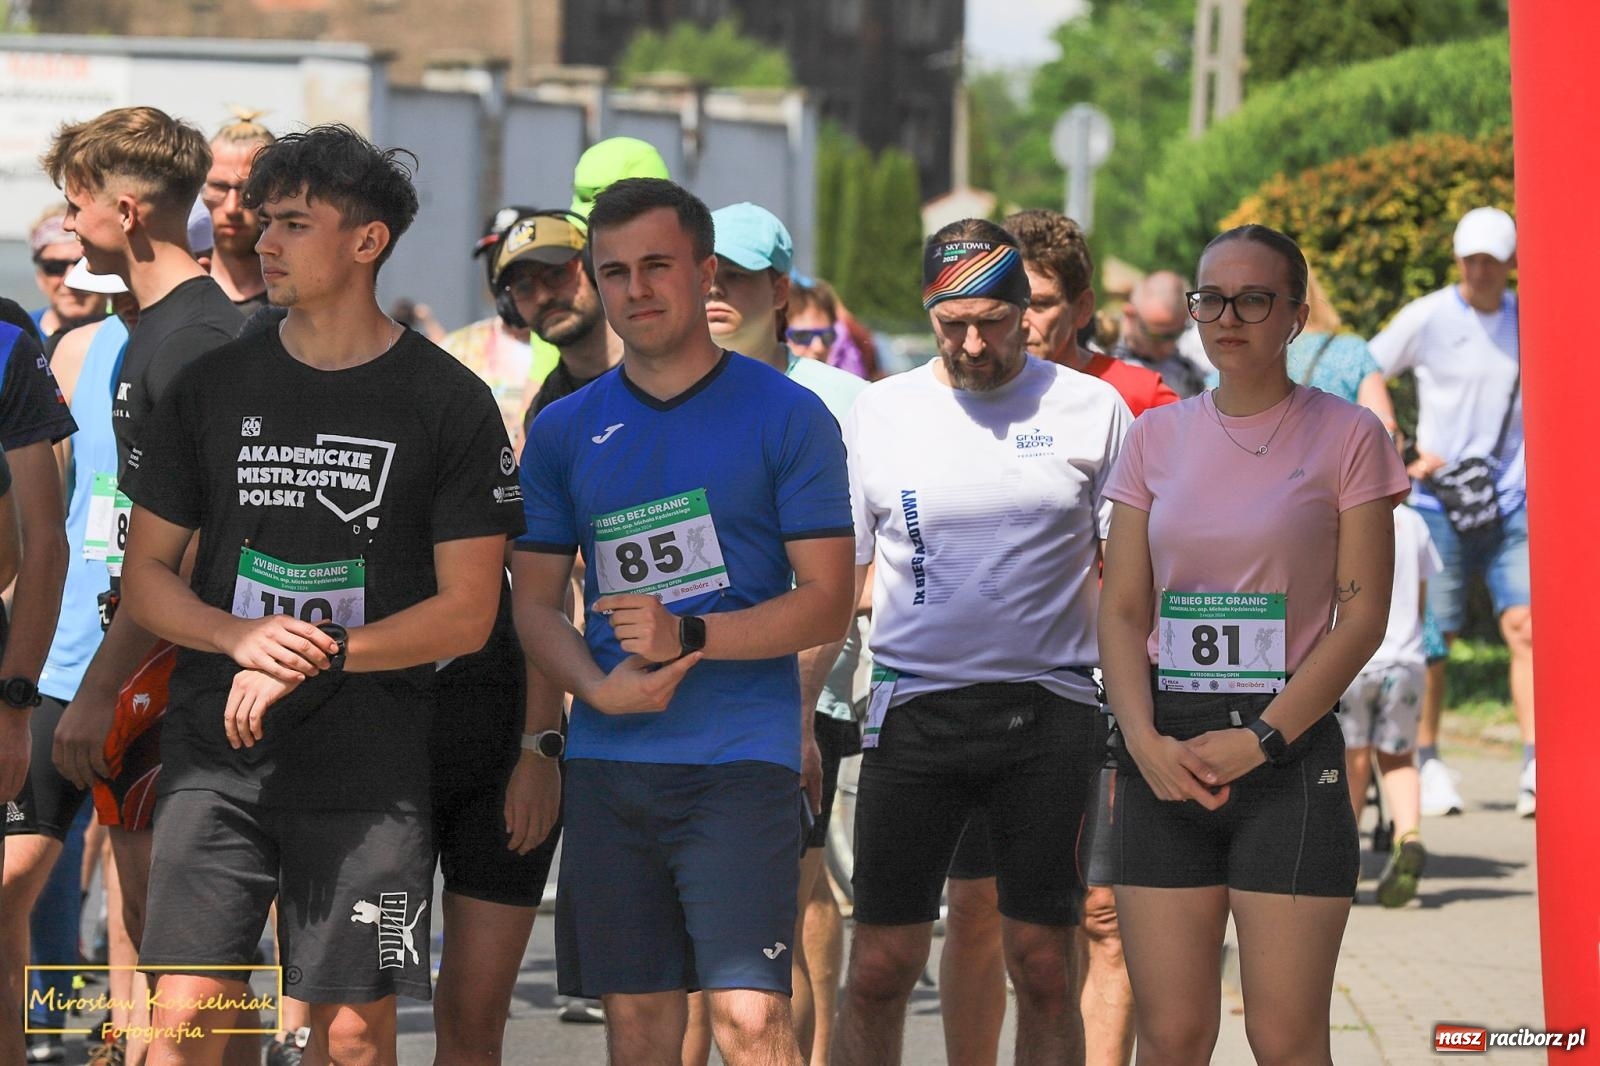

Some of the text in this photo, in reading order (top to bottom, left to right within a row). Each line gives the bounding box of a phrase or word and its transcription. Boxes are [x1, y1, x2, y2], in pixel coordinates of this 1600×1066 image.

[962, 242, 990, 250] TOWER
[943, 255, 958, 263] 2022
[237, 446, 373, 470] AKADEMICKIE
[237, 467, 371, 492] MISTRZOSTWA
[239, 489, 306, 508] POLSKI
[602, 514, 626, 528] BIEG
[626, 508, 647, 521] BEZ
[647, 497, 690, 515] GRANIC
[615, 530, 684, 583] 85
[901, 489, 926, 606] IX BIEG AZOTOWY
[253, 556, 348, 578] XVI BIEG BEZ GRANIC
[681, 582, 709, 594] Racibórz
[1169, 595, 1268, 605] XVI BIEG BEZ GRANIC
[261, 591, 333, 623] 110
[1192, 624, 1240, 666] 81
